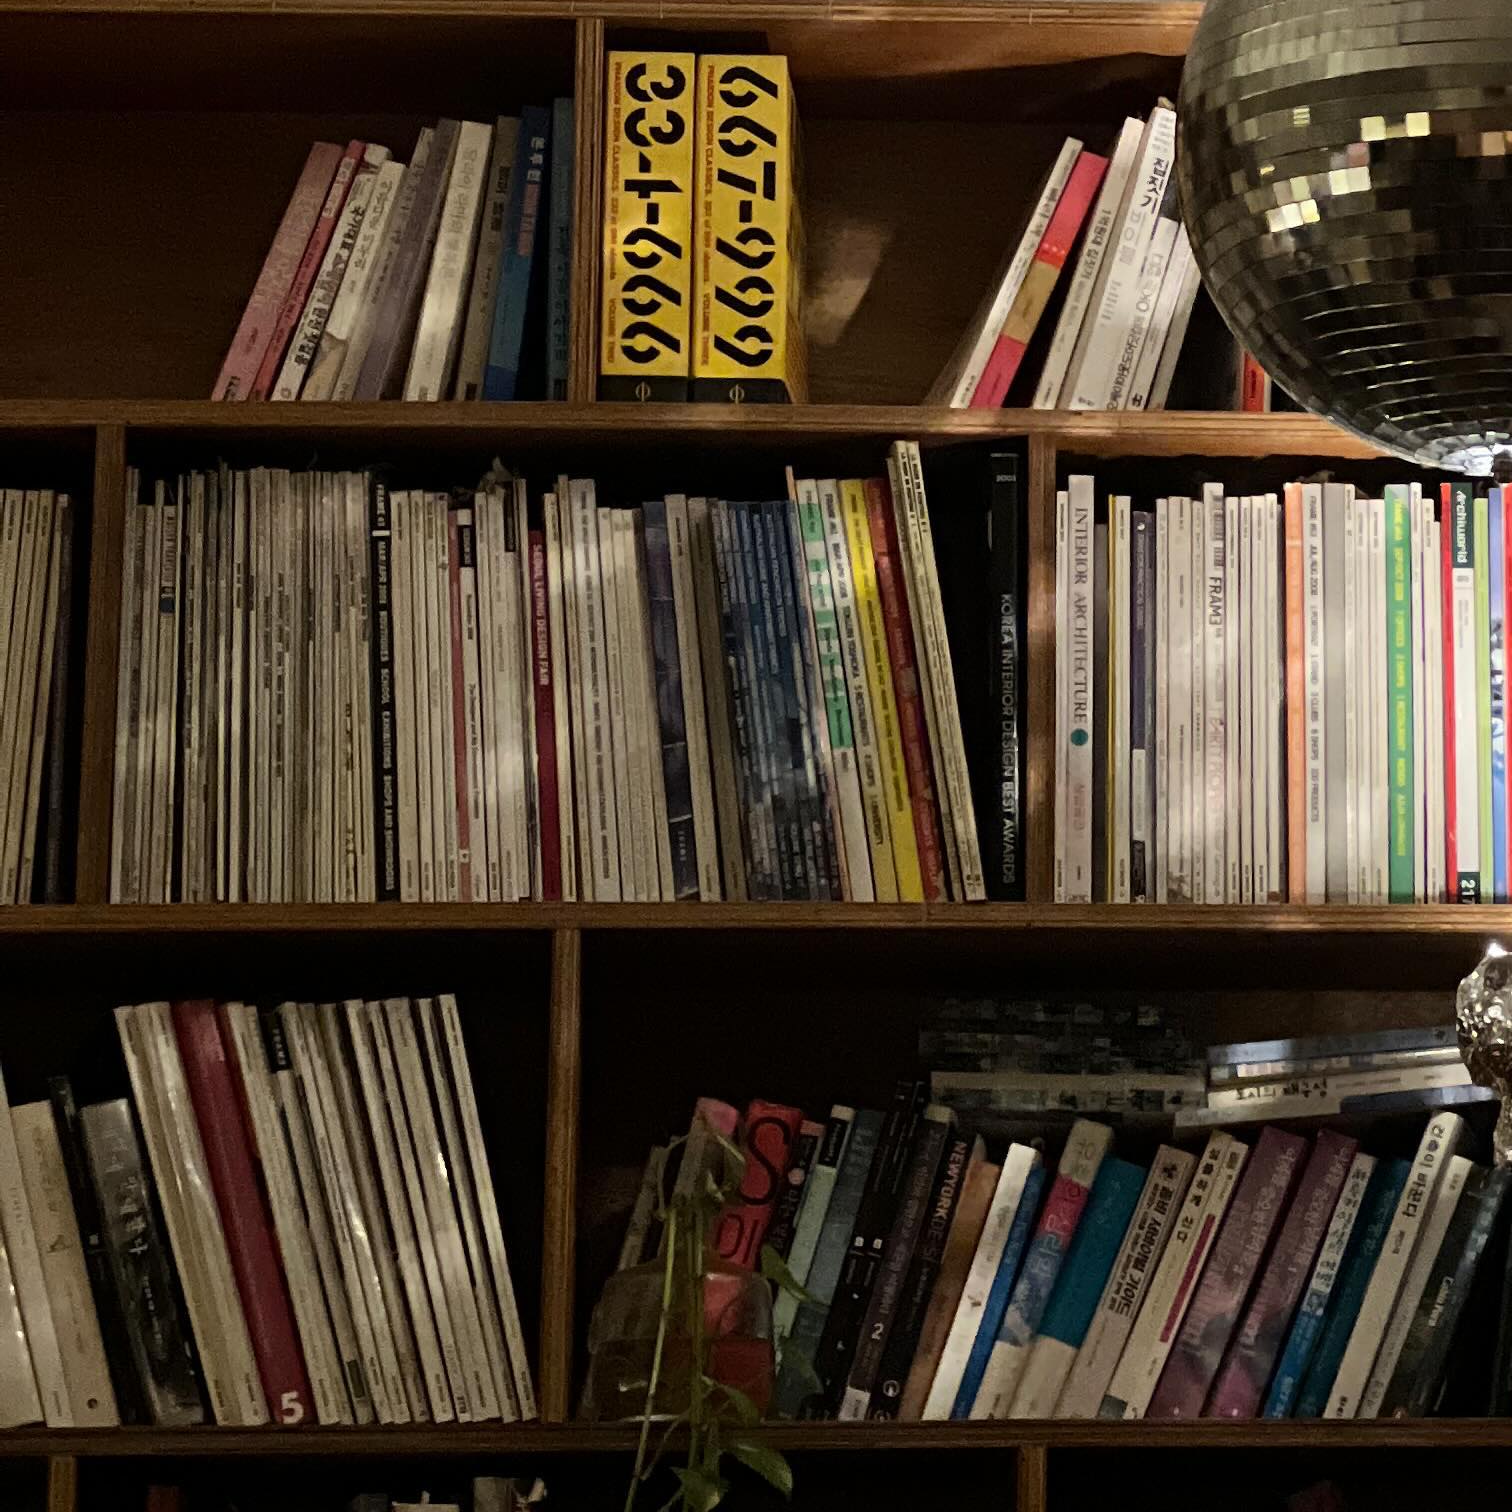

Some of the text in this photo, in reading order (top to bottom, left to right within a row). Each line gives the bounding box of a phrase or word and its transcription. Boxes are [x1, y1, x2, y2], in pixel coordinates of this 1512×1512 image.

[620, 63, 686, 364] 334-666
[714, 66, 778, 368] 667-999
[1455, 490, 1468, 563] Archiworld
[530, 543, 550, 685] SEOUL LIVING DESIGN FAIR
[1072, 507, 1089, 723] INTERIOR ARCHITECTURE
[999, 593, 1014, 883] KOREA INTERIOR DESIGN BEST AWARDS
[1401, 1171, 1429, 1219] 바꾼다
[870, 1322, 885, 1342] 2
[1114, 1273, 1141, 1316] 가이드
[280, 1390, 304, 1424] 5
